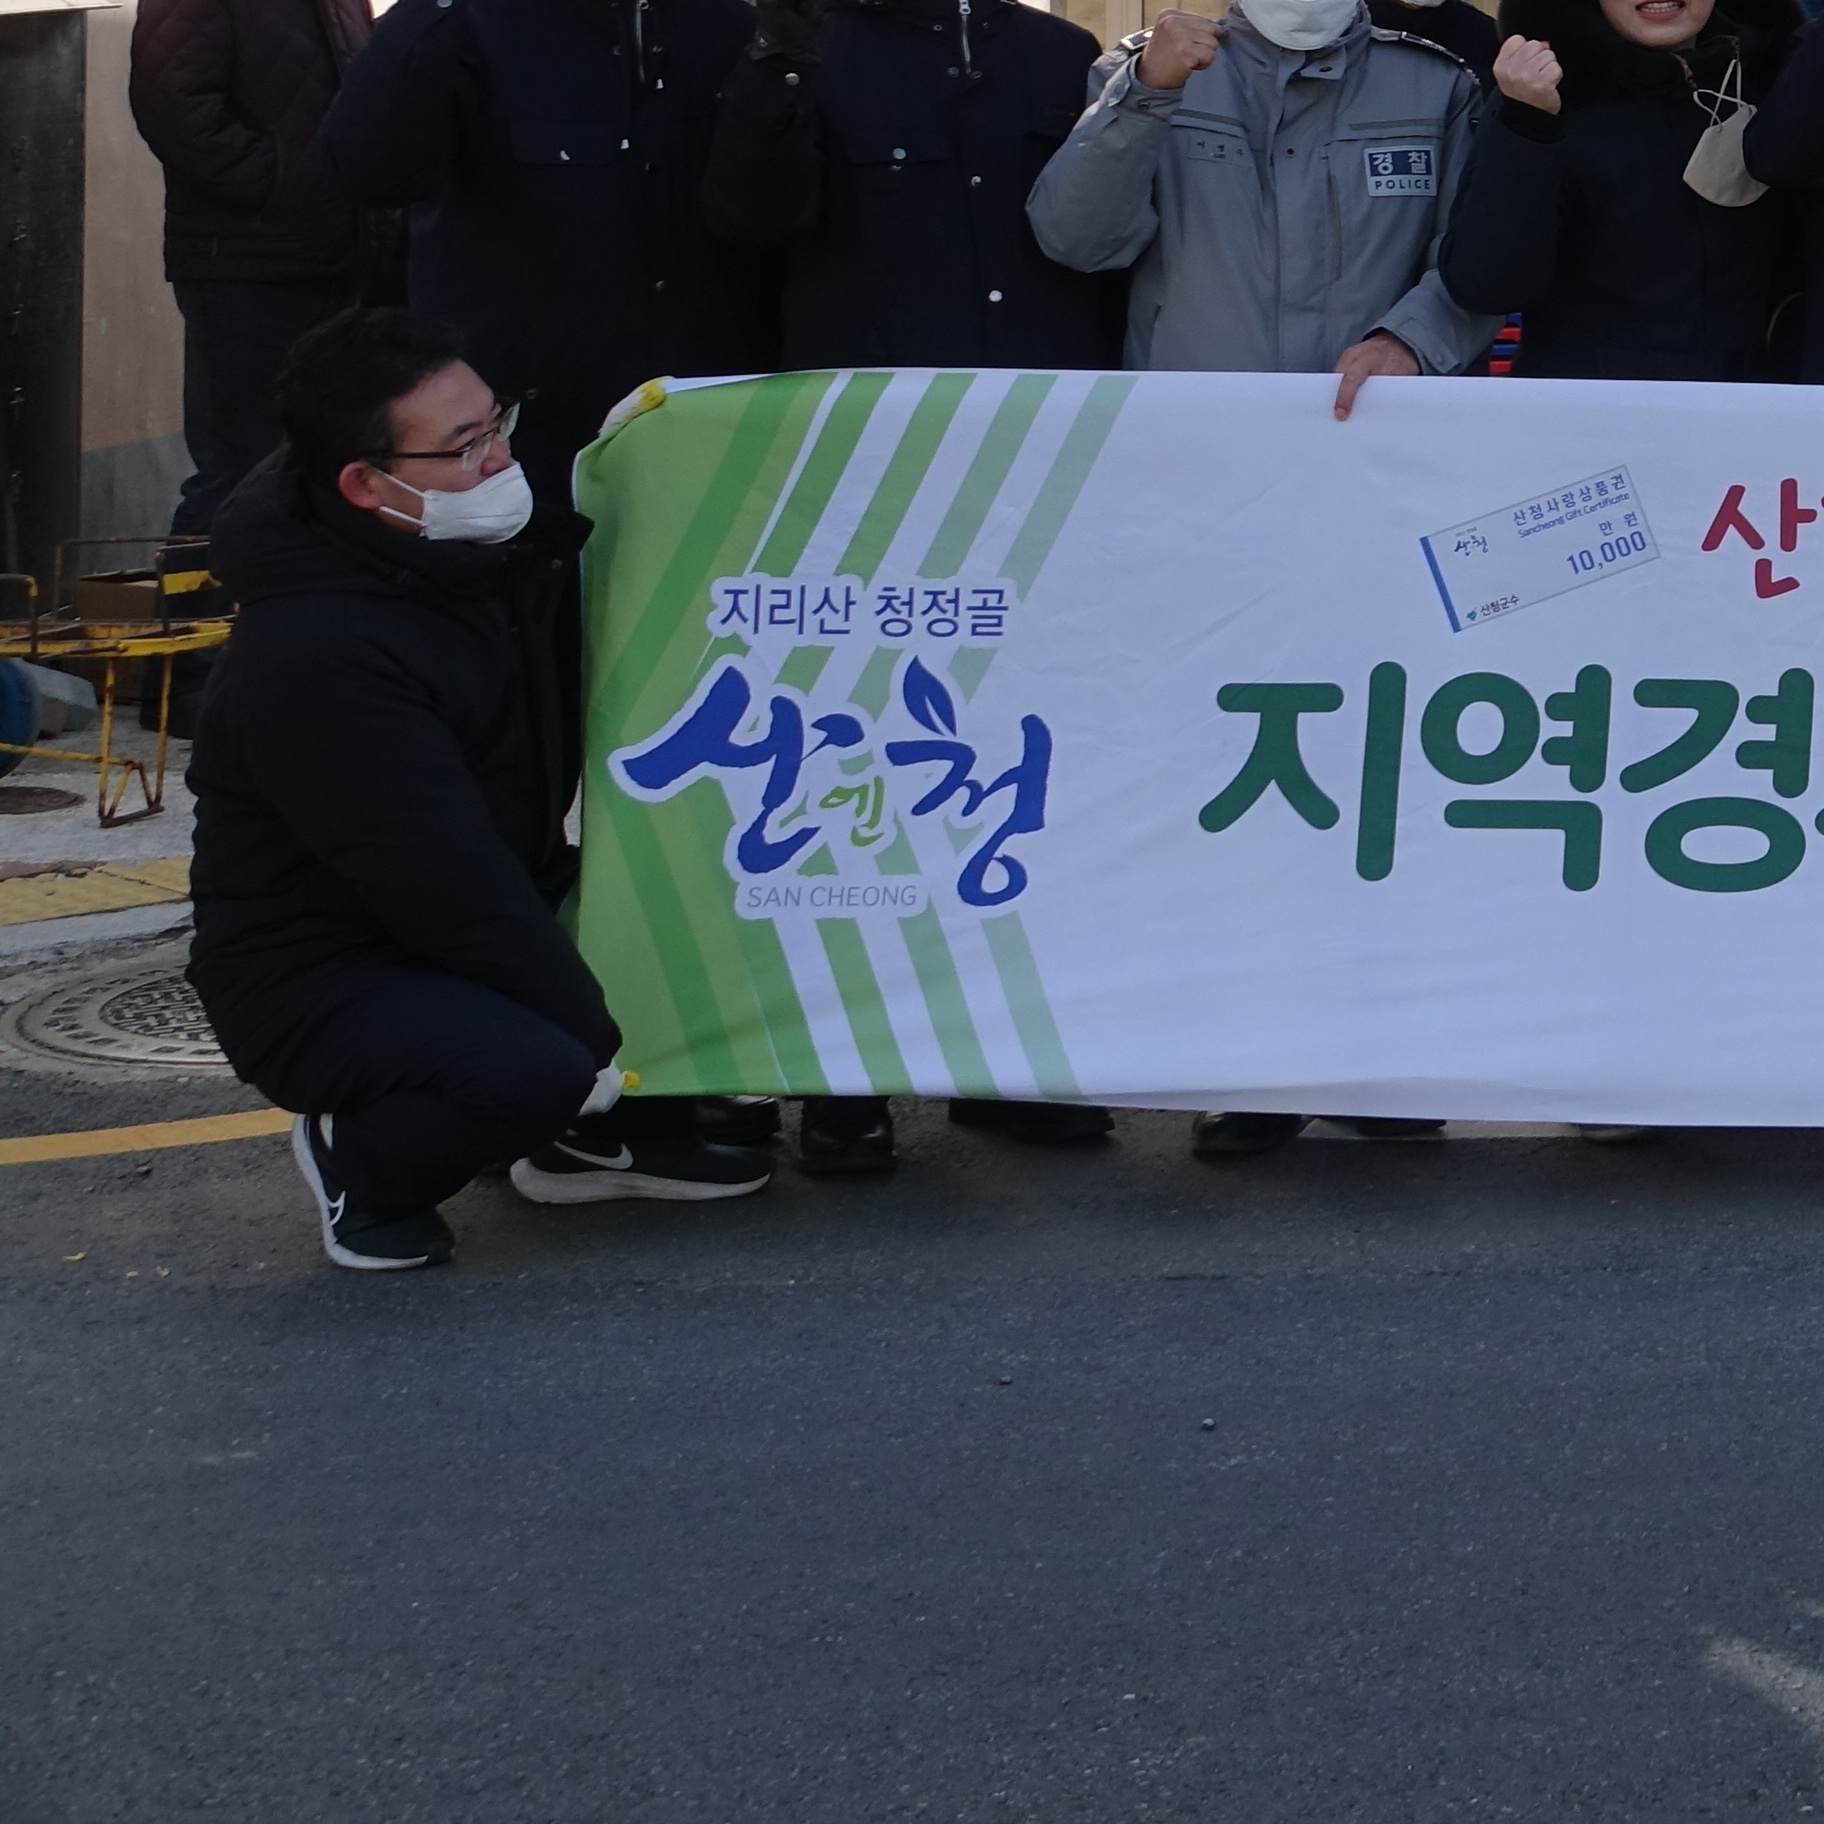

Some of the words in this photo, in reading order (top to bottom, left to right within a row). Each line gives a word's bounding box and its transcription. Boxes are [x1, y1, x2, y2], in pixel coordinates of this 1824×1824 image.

[1375, 179, 1431, 190] POLICE
[1512, 473, 1627, 527] 산청사랑상품권
[1566, 529, 1648, 576] 10,000
[719, 583, 856, 636] 지리산
[874, 585, 1010, 639] 청정골
[1480, 594, 1521, 617] 산청군수
[747, 886, 801, 909] SAN
[809, 884, 918, 909] CHEONG
